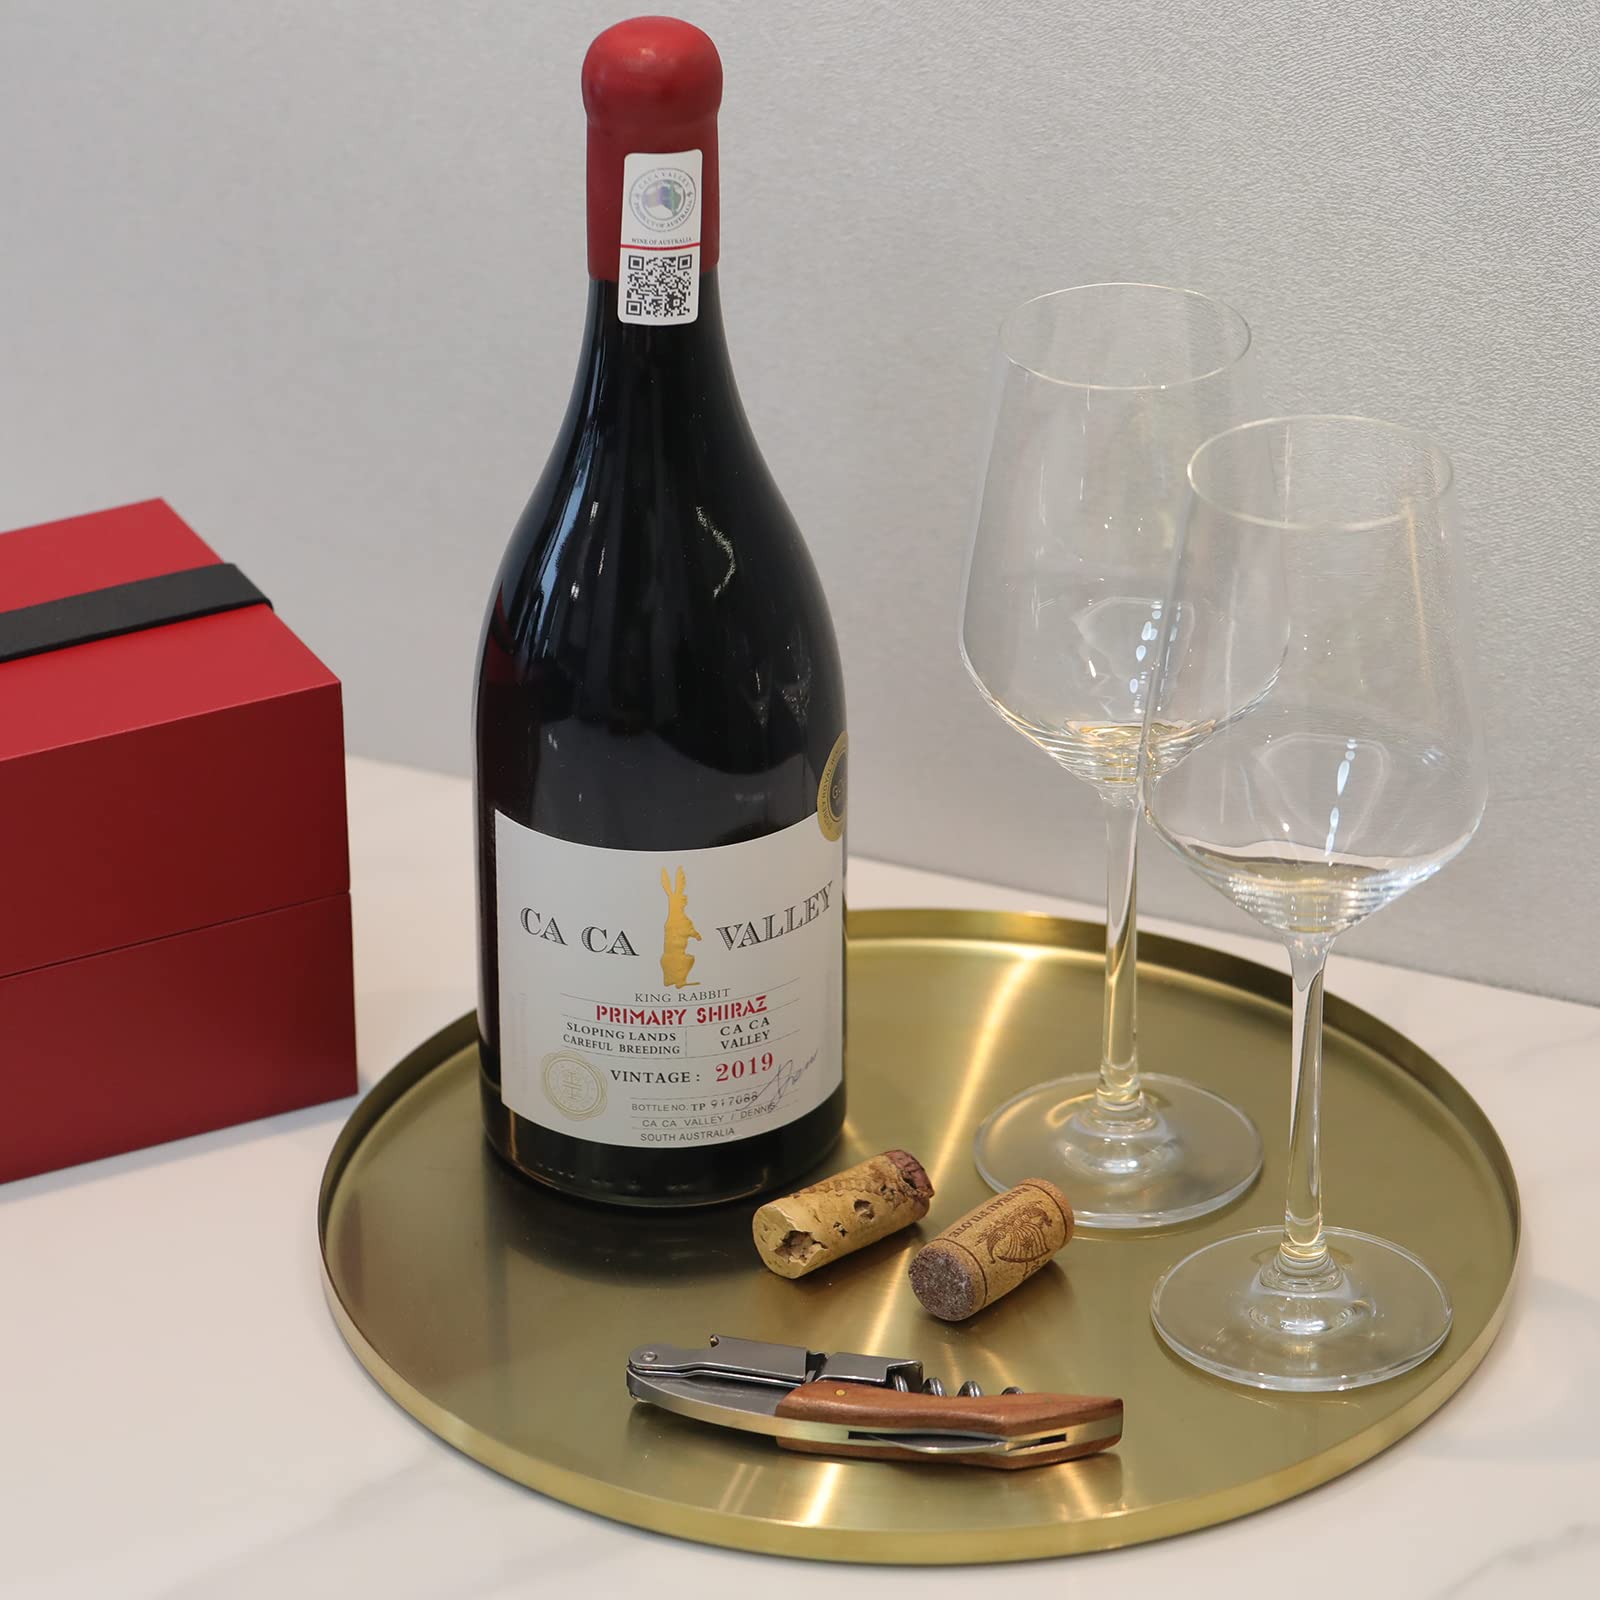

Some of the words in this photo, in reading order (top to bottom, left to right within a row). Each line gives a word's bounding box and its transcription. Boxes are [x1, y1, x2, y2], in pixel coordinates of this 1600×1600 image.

[658, 236, 692, 245] AUSTRALIA
[520, 907, 568, 946] CA
[581, 926, 640, 957] CA
[716, 880, 833, 951] VALLEY
[635, 993, 671, 1003] KING
[678, 988, 731, 1002] RABBIT
[596, 1005, 687, 1026] PRIMARY
[697, 995, 768, 1024] SHIRAZ
[566, 1022, 625, 1040] SLOPING
[629, 1032, 676, 1042] LANDS
[720, 1024, 743, 1036] CA
[749, 1017, 770, 1030] CA
[563, 1034, 613, 1051] CAREFUL
[619, 1044, 680, 1054] BREEDING
[720, 1030, 770, 1050] VALLEY
[715, 1052, 774, 1082] 2019
[631, 1103, 670, 1112] BOTTLE
[691, 1103, 706, 1112] TP
[642, 1119, 657, 1128] CA
[662, 1119, 677, 1128] CA
[684, 1115, 725, 1127] VALLEY
[640, 1133, 676, 1142] SOUTH
[679, 1127, 735, 1142] AUSTRALIA
